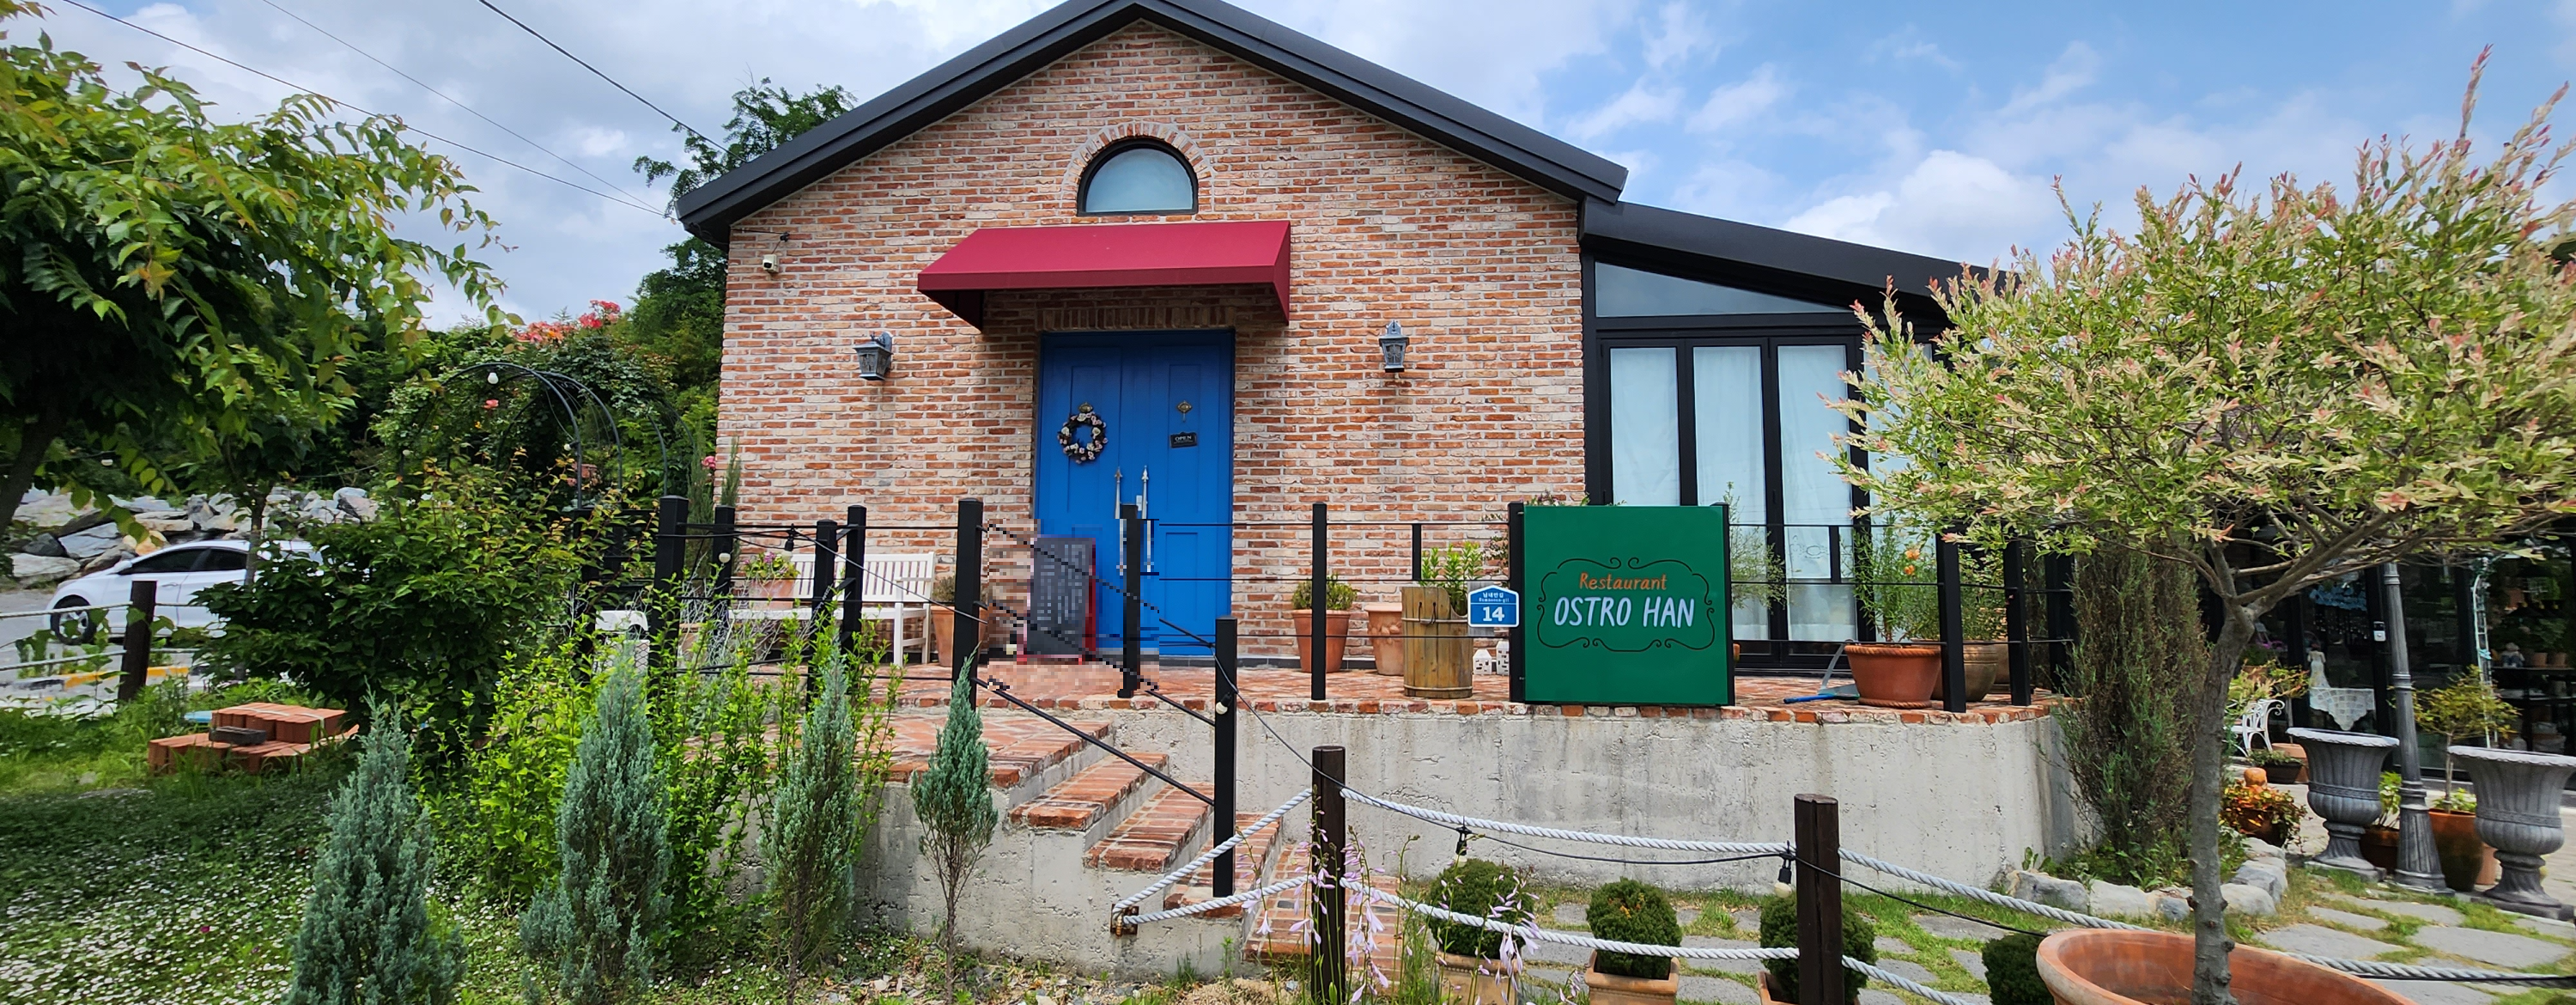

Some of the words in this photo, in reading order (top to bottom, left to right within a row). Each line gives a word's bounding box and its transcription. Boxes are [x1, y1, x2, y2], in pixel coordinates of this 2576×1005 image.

[1579, 572, 1668, 591] Restaurant
[1483, 606, 1505, 622] 14
[1554, 596, 1631, 626] OSTRO
[1643, 596, 1695, 628] HAN
